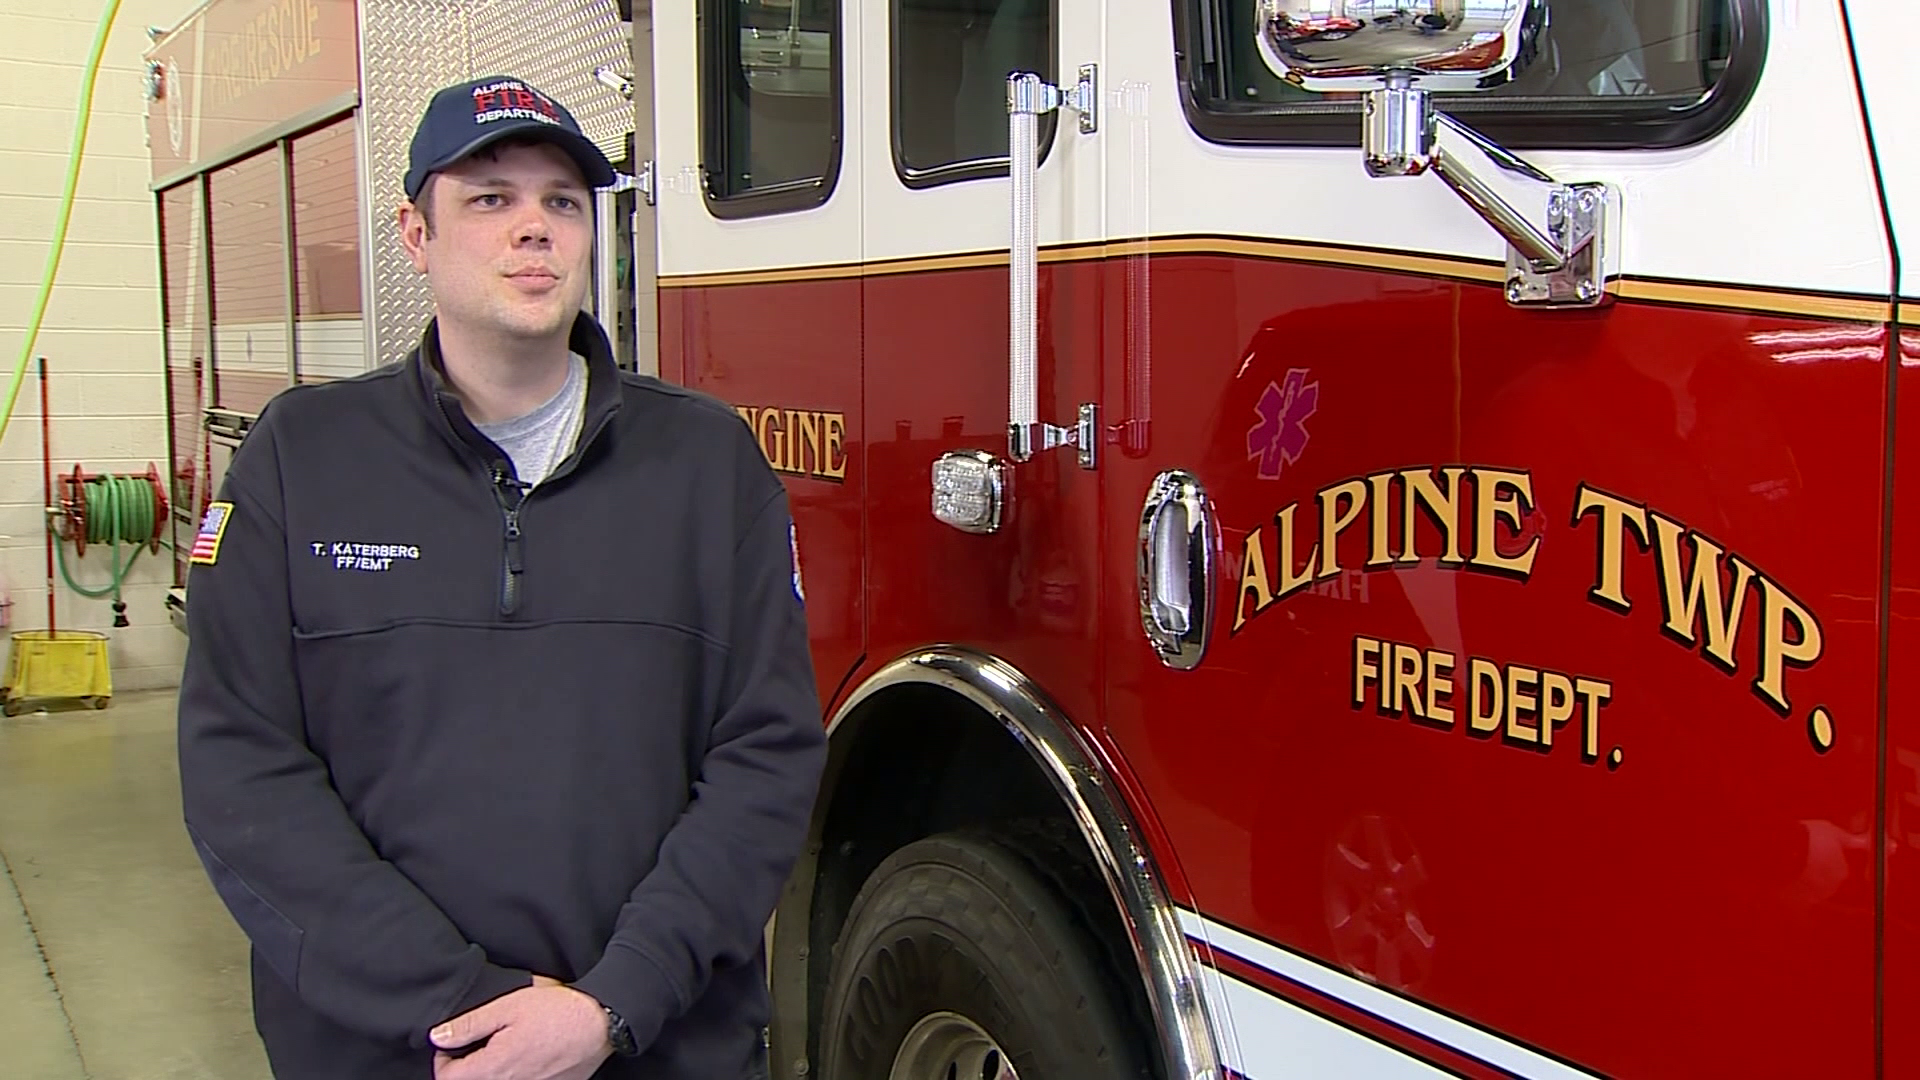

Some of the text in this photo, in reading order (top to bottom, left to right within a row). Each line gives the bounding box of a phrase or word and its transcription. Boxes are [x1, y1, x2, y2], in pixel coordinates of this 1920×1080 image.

[472, 82, 525, 97] ALPINE
[474, 90, 560, 123] FIRE
[731, 405, 848, 482] NGINE
[311, 542, 420, 559] T. KATERBERG
[337, 556, 393, 571] FF/EMT
[1231, 464, 1836, 753] ALPINE TWP.
[1351, 633, 1624, 772] FIRE DEPT.
